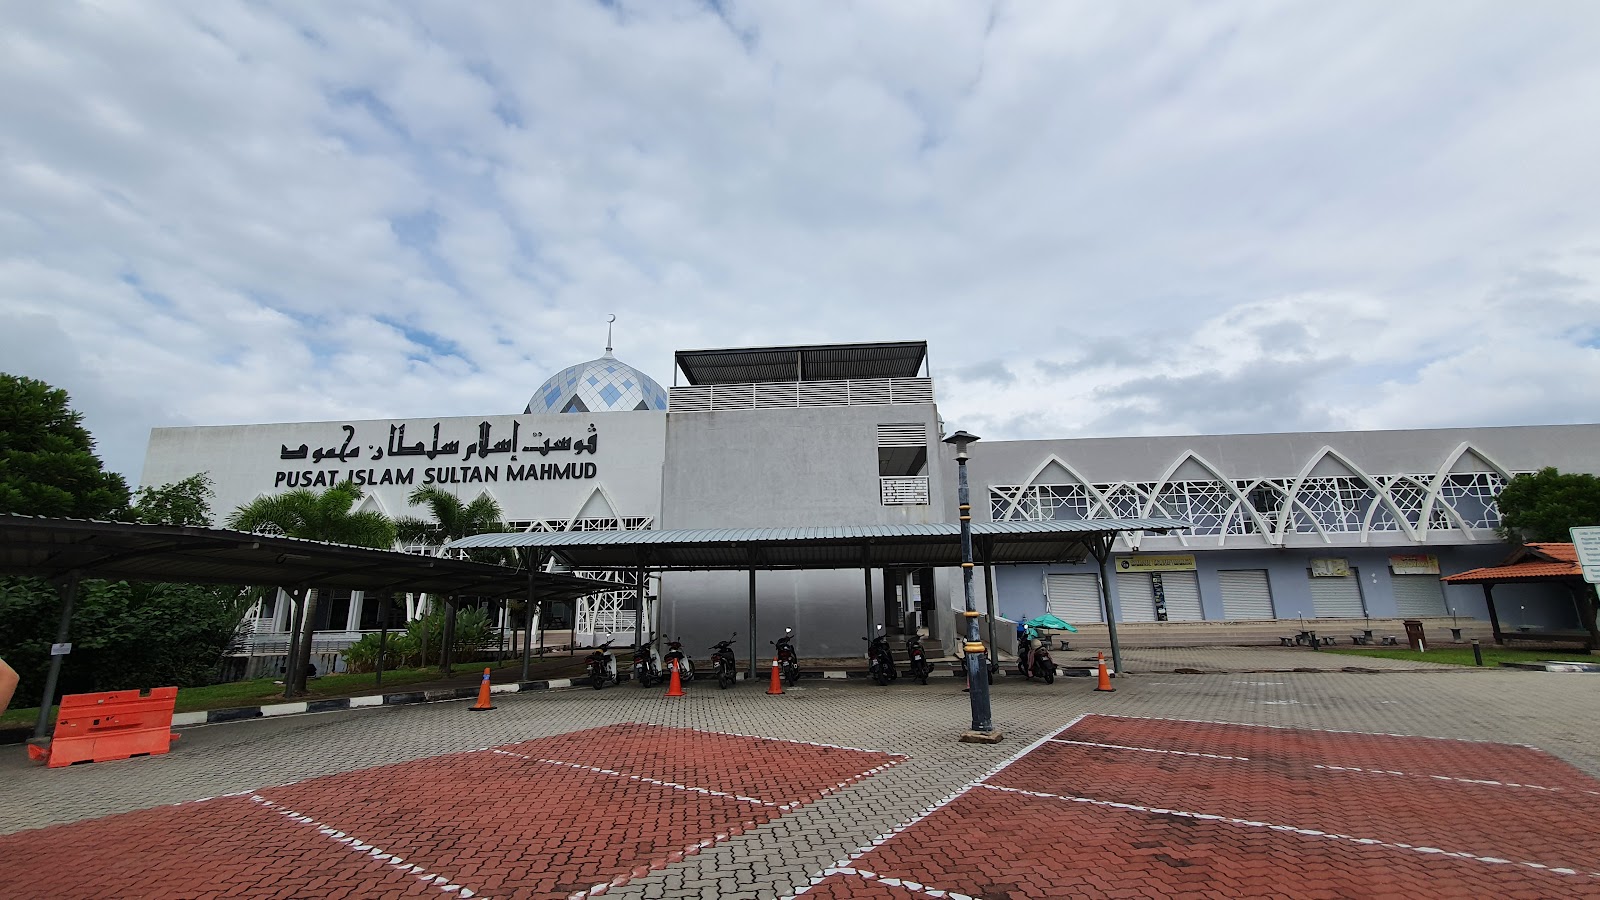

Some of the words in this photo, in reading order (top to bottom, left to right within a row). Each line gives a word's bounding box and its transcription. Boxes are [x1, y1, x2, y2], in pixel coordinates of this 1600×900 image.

[280, 425, 360, 464] محمود
[274, 470, 339, 488] PUSAT
[347, 467, 414, 486] ISLAM
[422, 465, 498, 485] SULTAN
[506, 461, 597, 482] MAHMUD
